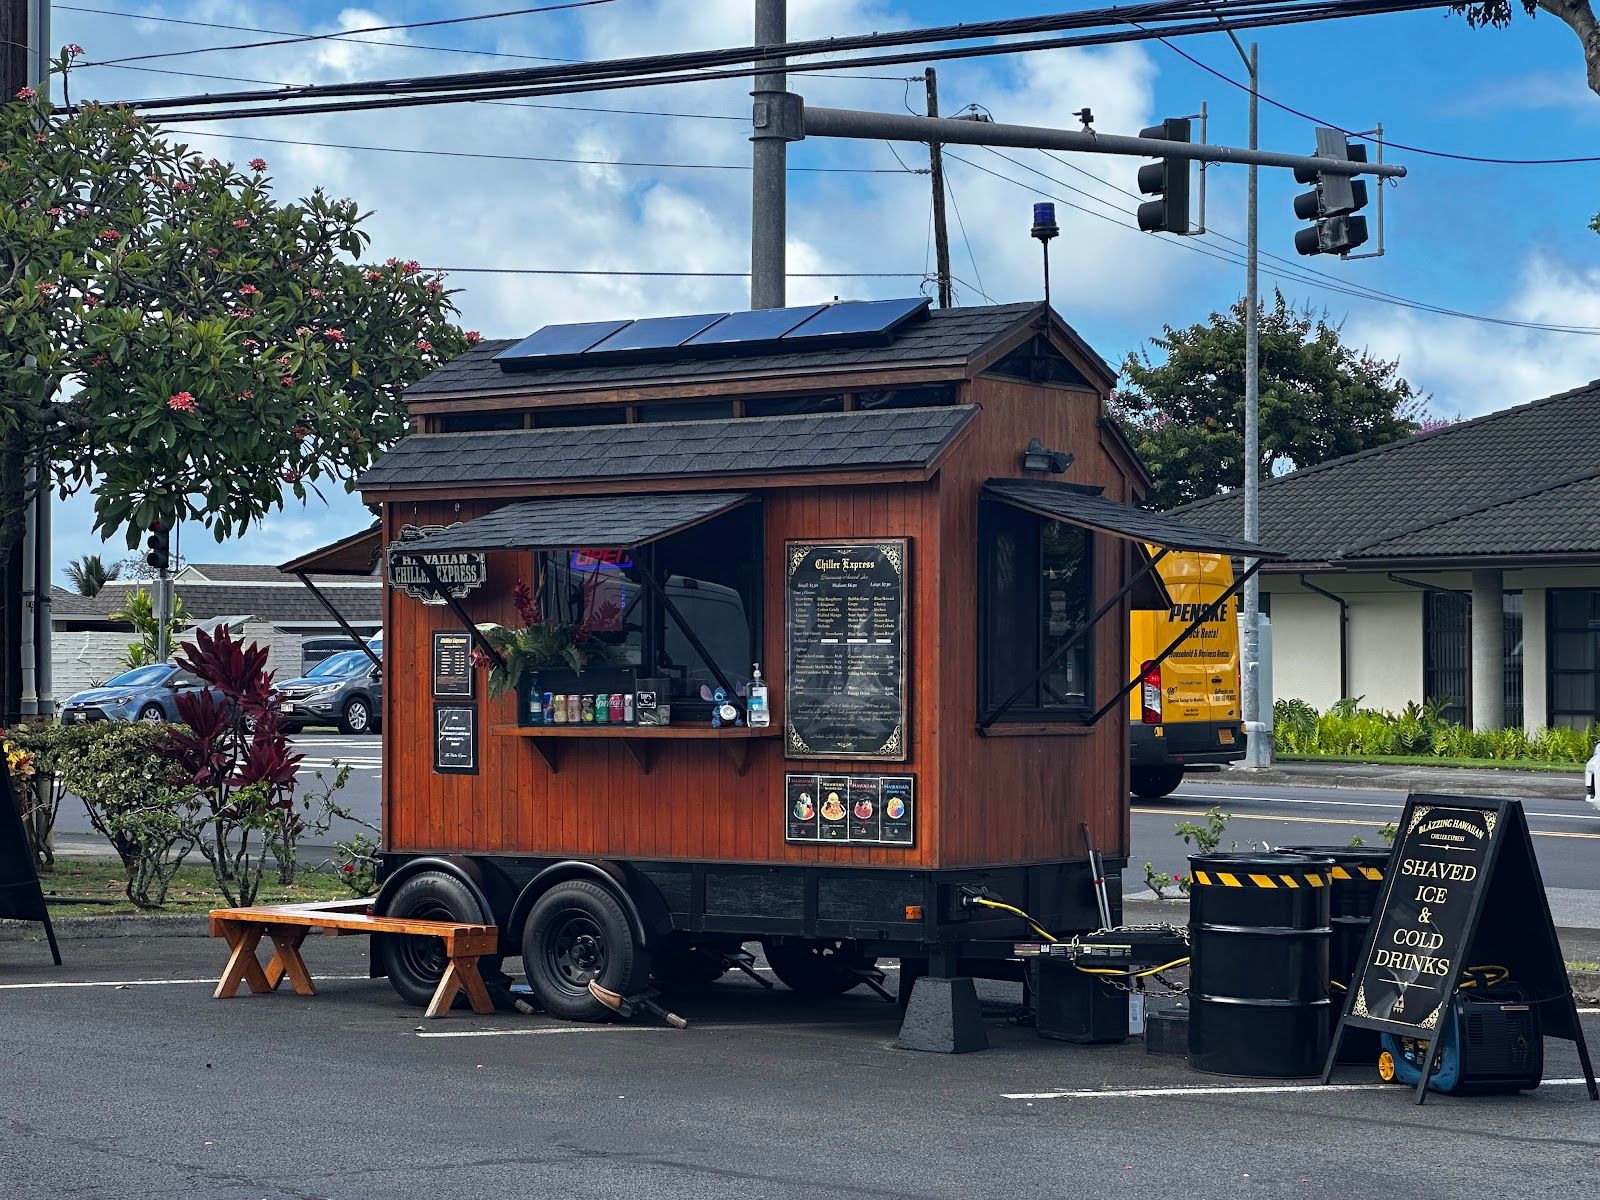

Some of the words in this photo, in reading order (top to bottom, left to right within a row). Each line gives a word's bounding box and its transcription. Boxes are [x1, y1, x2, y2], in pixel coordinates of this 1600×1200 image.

[815, 559, 840, 571] Chiller
[841, 558, 874, 572] Express
[1453, 819, 1484, 839] HAWAIIAN
[1402, 859, 1476, 882] SHAVED
[1415, 886, 1448, 904] ICE
[1418, 907, 1432, 923] &
[1393, 928, 1444, 949] COLD
[1374, 950, 1449, 976] DRINKS
